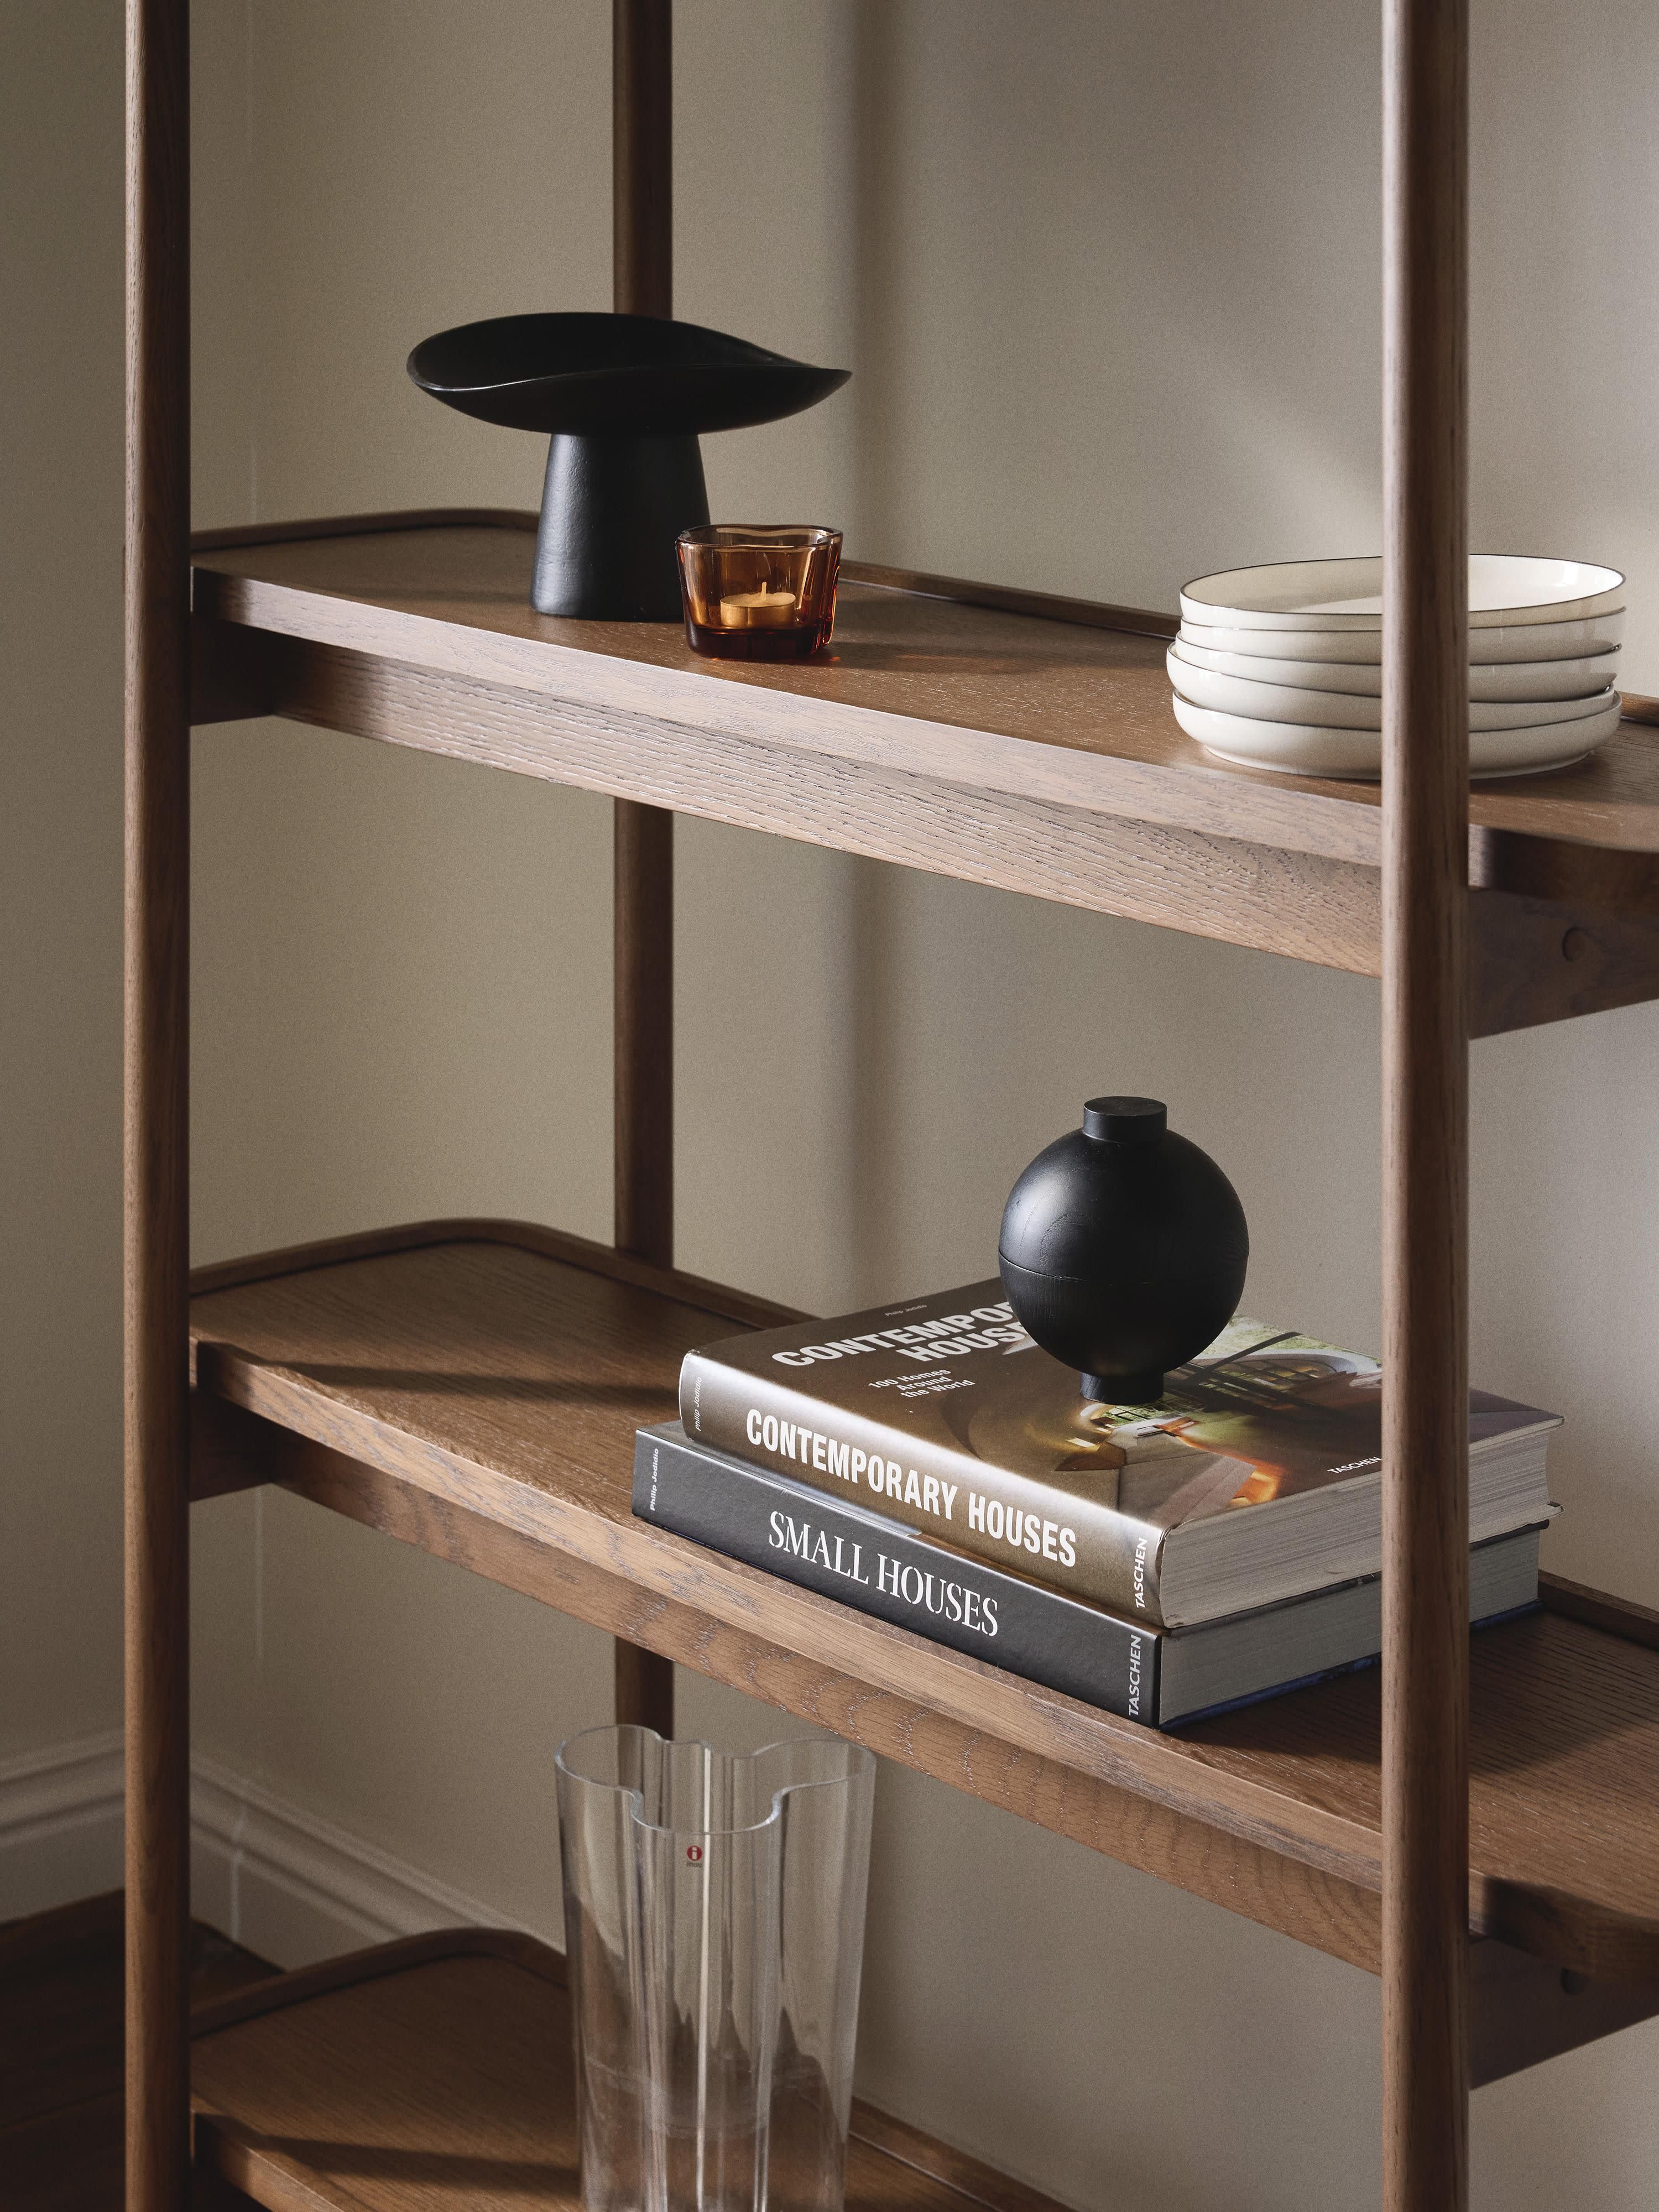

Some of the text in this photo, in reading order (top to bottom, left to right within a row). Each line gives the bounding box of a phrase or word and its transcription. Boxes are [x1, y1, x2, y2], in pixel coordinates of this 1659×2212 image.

[693, 1376, 702, 1407] Jodidio
[868, 1369, 951, 1388] 100 Homes
[896, 1376, 953, 1390] Around
[927, 1380, 975, 1391] World
[1327, 1457, 1382, 1473] TASCHEN
[747, 1408, 1076, 1567] CONTEMPORARY HOUSES
[769, 1511, 999, 1636] SMALL HOUSES
[1134, 1537, 1147, 1608] TASCHEN
[1129, 1634, 1141, 1715] TASCHEN
